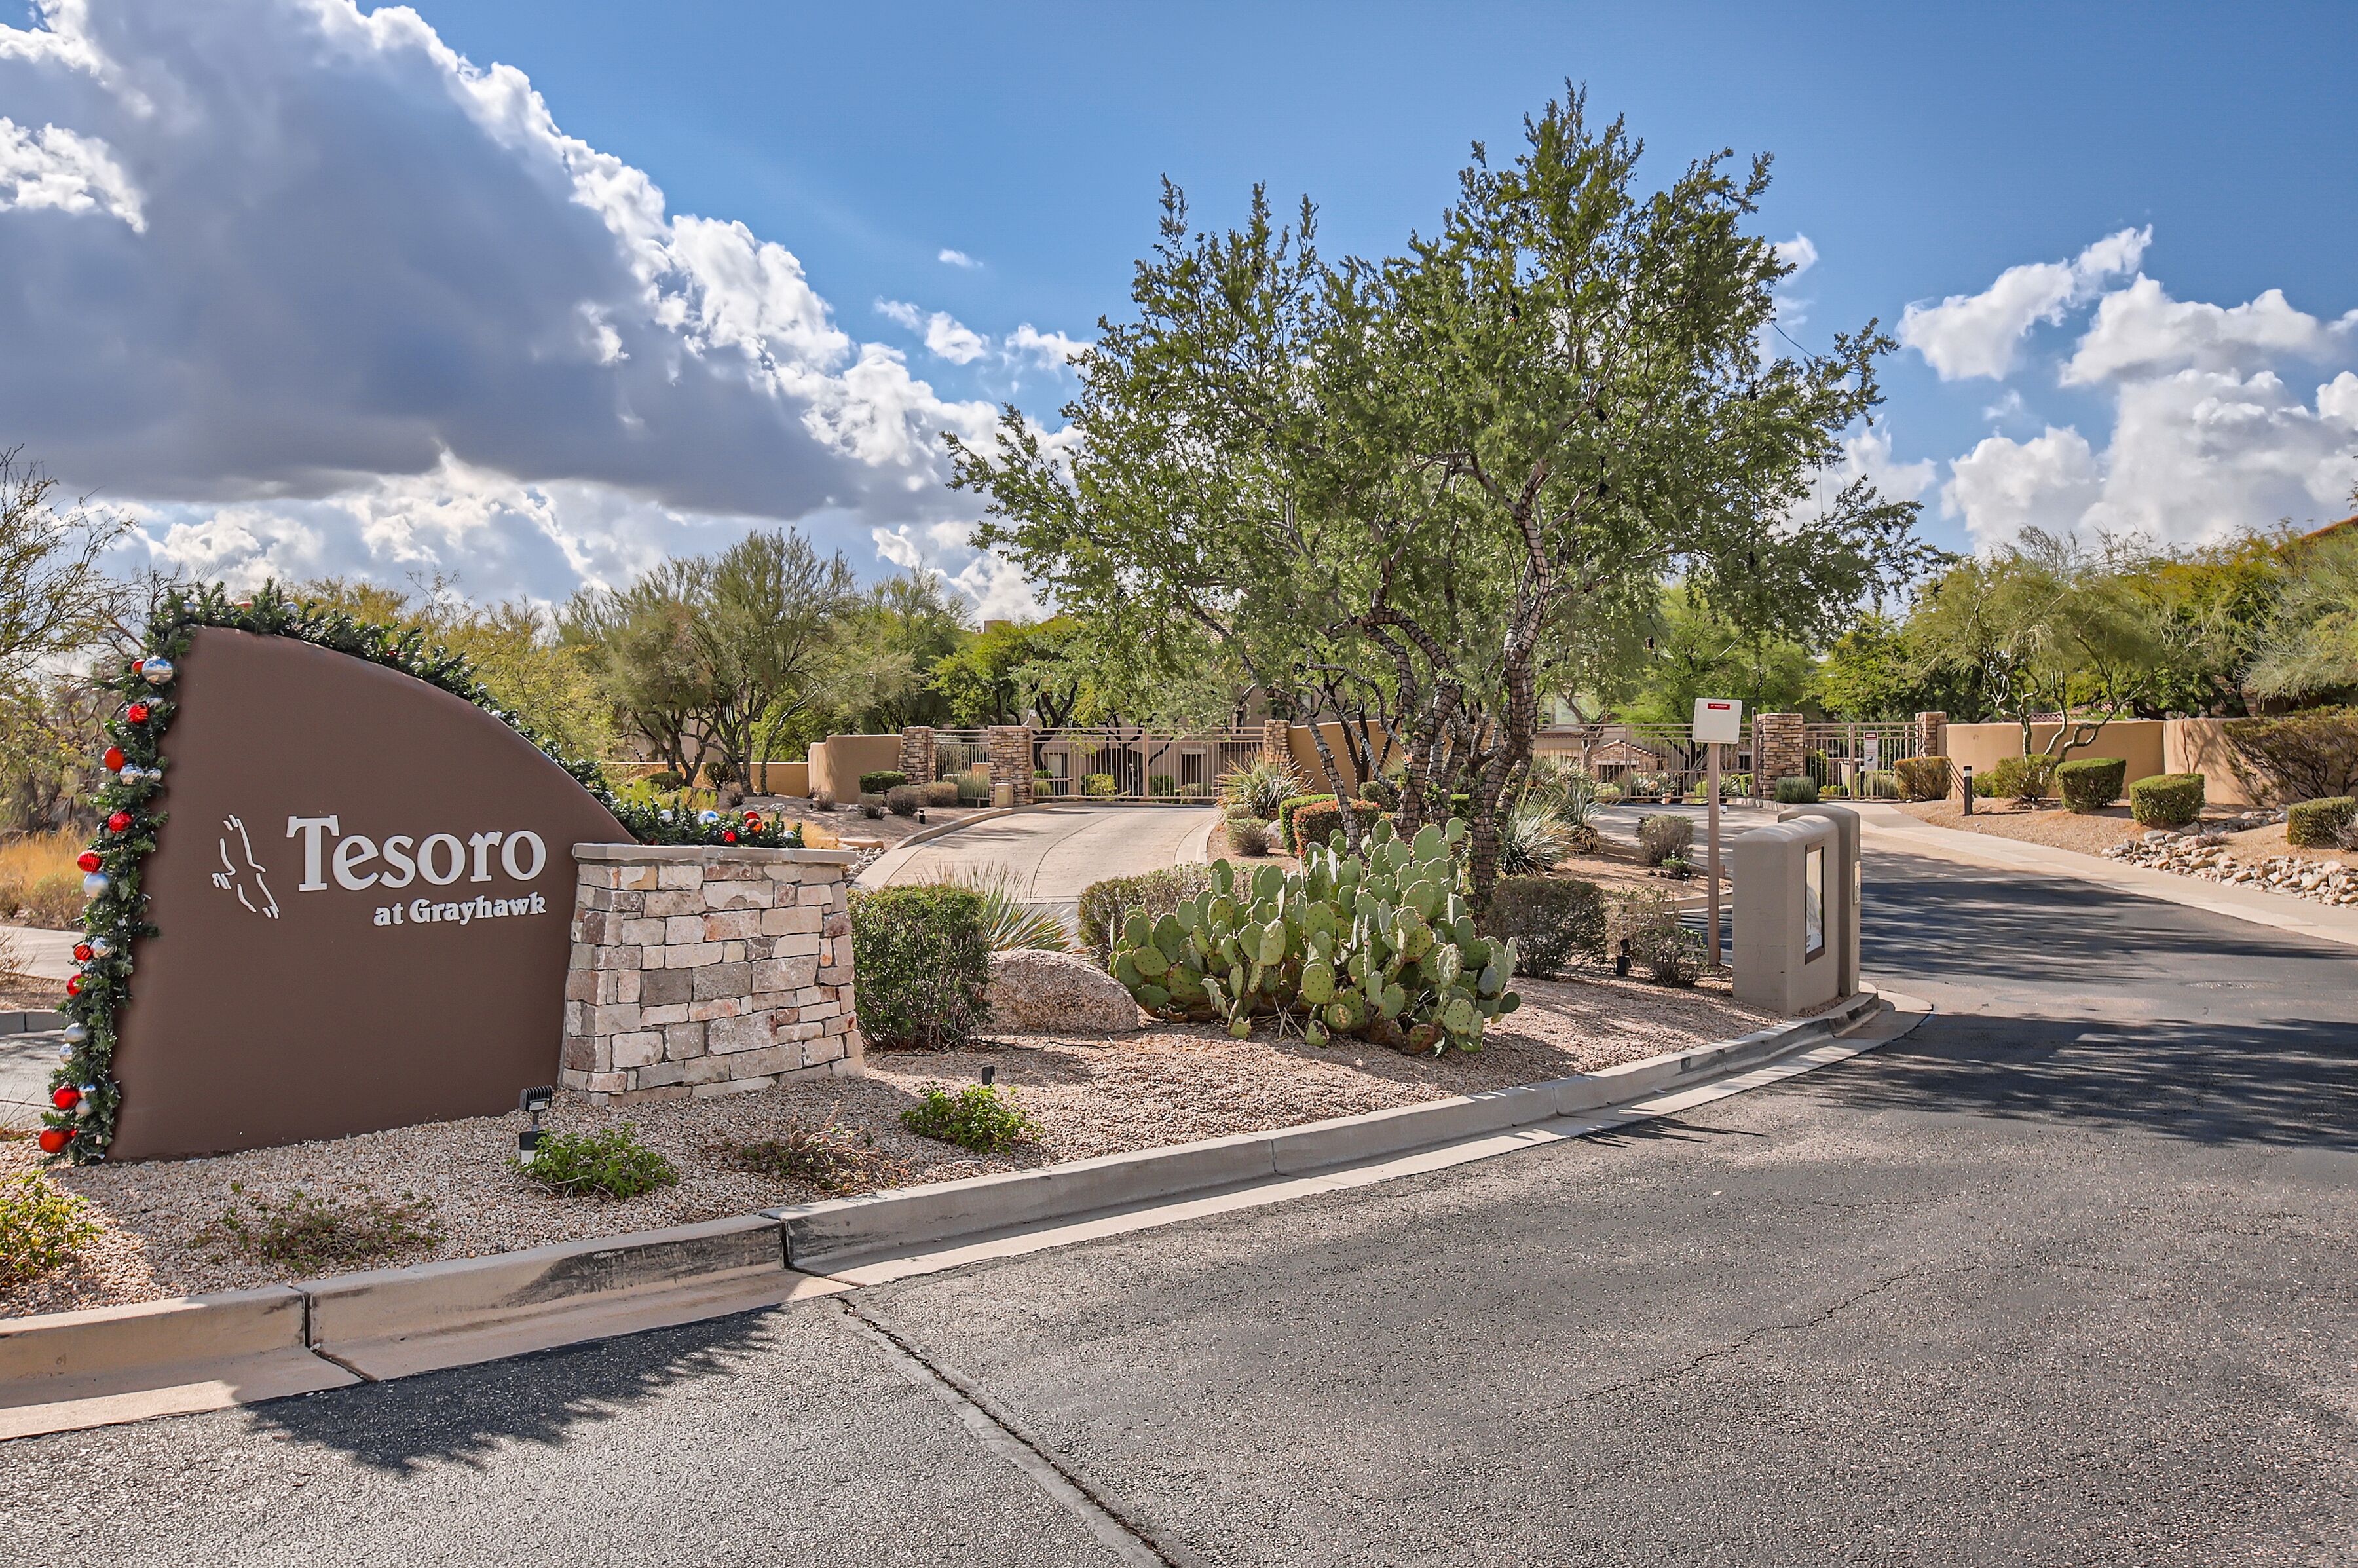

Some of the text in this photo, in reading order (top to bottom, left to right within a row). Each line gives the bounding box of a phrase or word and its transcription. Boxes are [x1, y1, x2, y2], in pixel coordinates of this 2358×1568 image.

[286, 815, 547, 892] Tesoro
[373, 891, 547, 927] at Grayhawk
